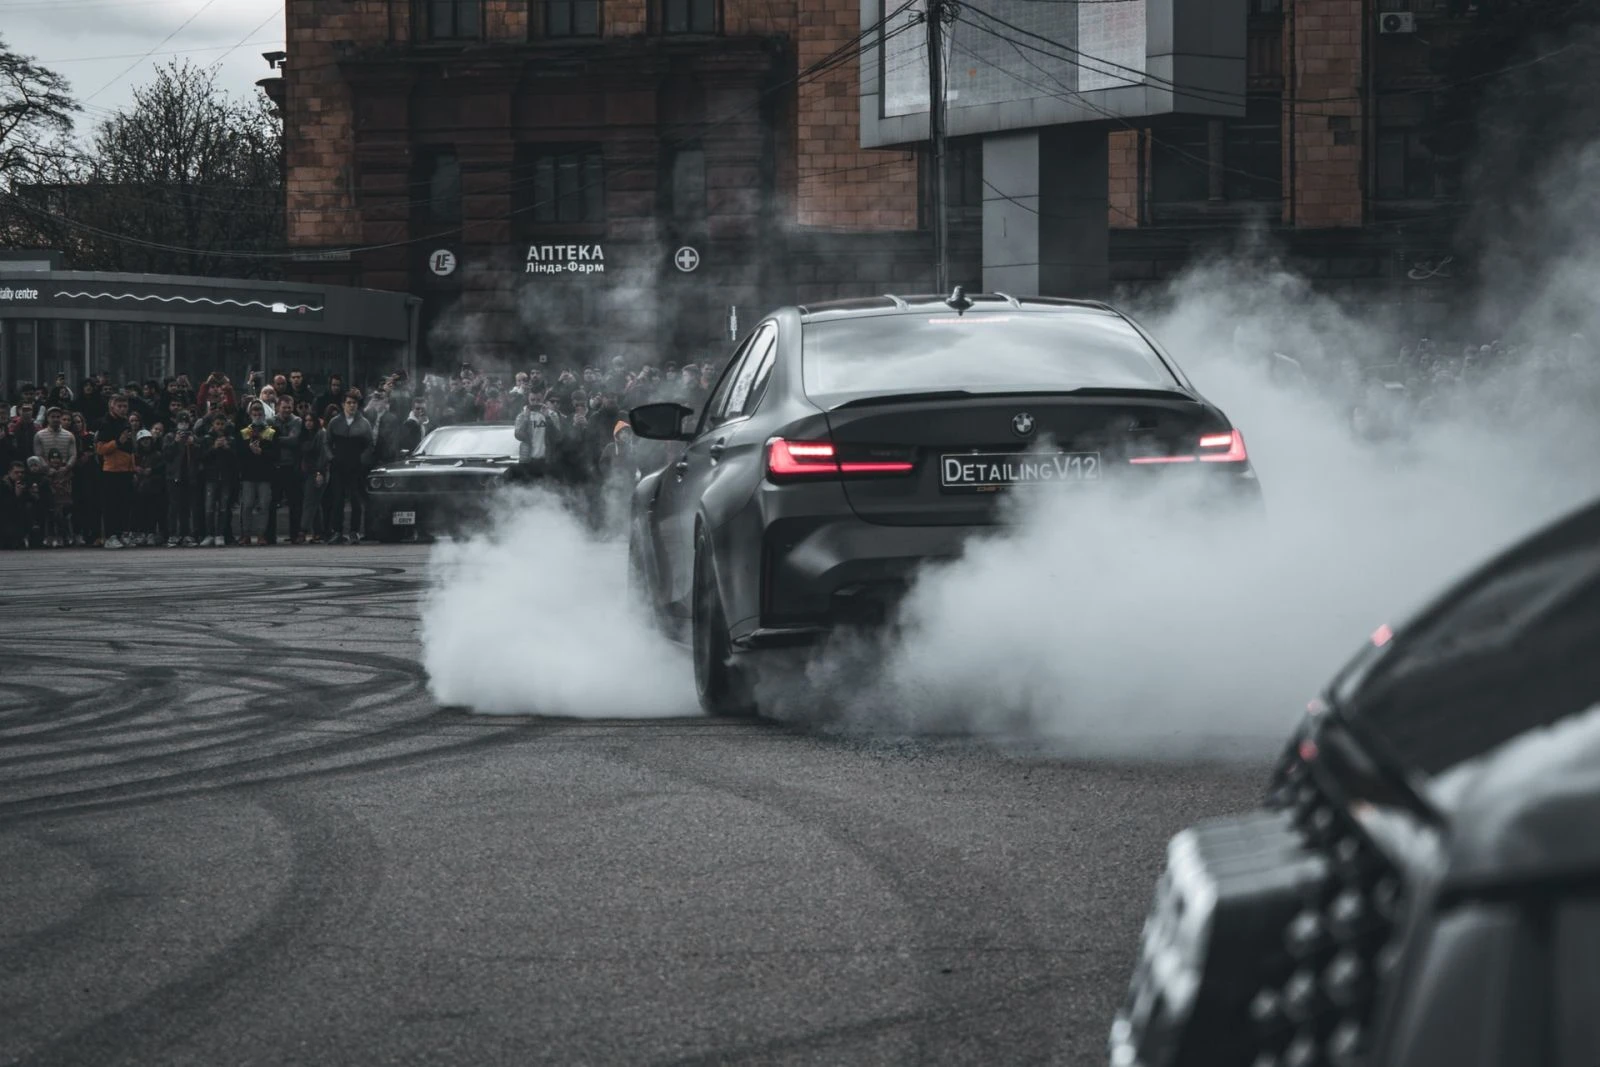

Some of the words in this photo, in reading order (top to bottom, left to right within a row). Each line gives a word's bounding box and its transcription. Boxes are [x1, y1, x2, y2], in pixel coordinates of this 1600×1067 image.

[527, 245, 604, 260] АПТЕКА
[525, 261, 604, 274] Лінда-Фарм
[15, 287, 38, 300] centre
